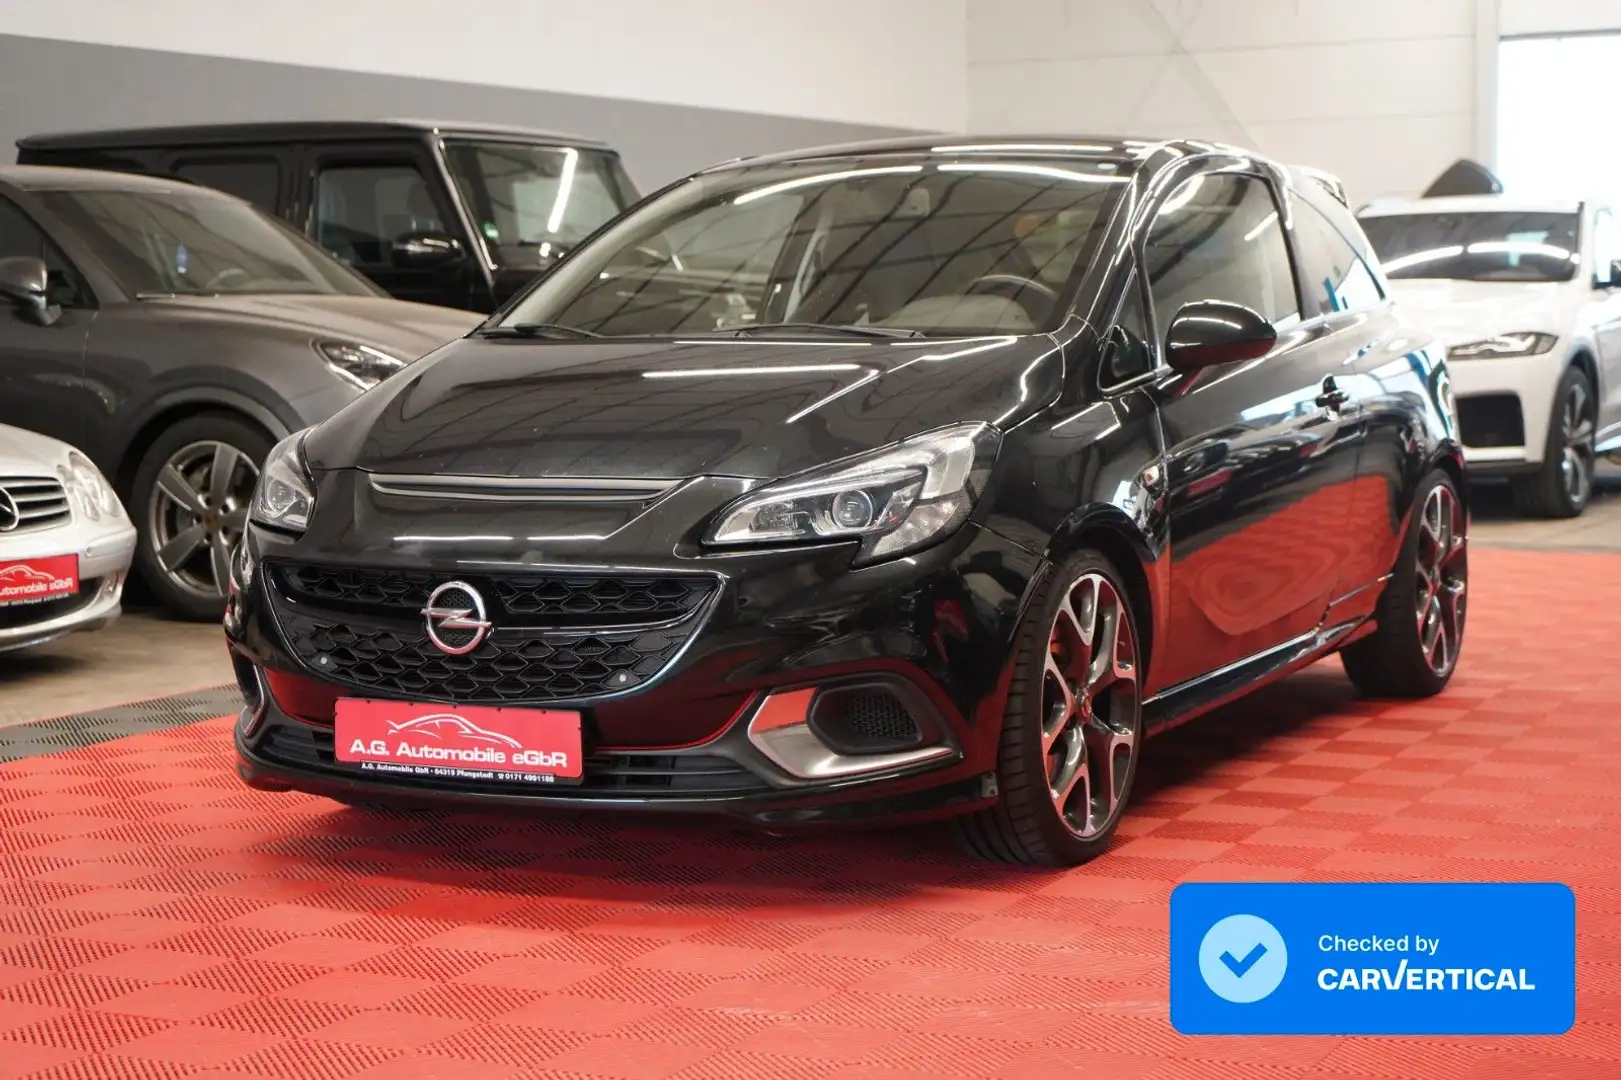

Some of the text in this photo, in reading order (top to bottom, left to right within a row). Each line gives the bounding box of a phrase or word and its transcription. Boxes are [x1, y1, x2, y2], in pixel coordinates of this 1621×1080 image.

[350, 739, 568, 768] A.G. Automobile eGbR
[376, 763, 413, 774] Automobile
[415, 765, 429, 774] GbR
